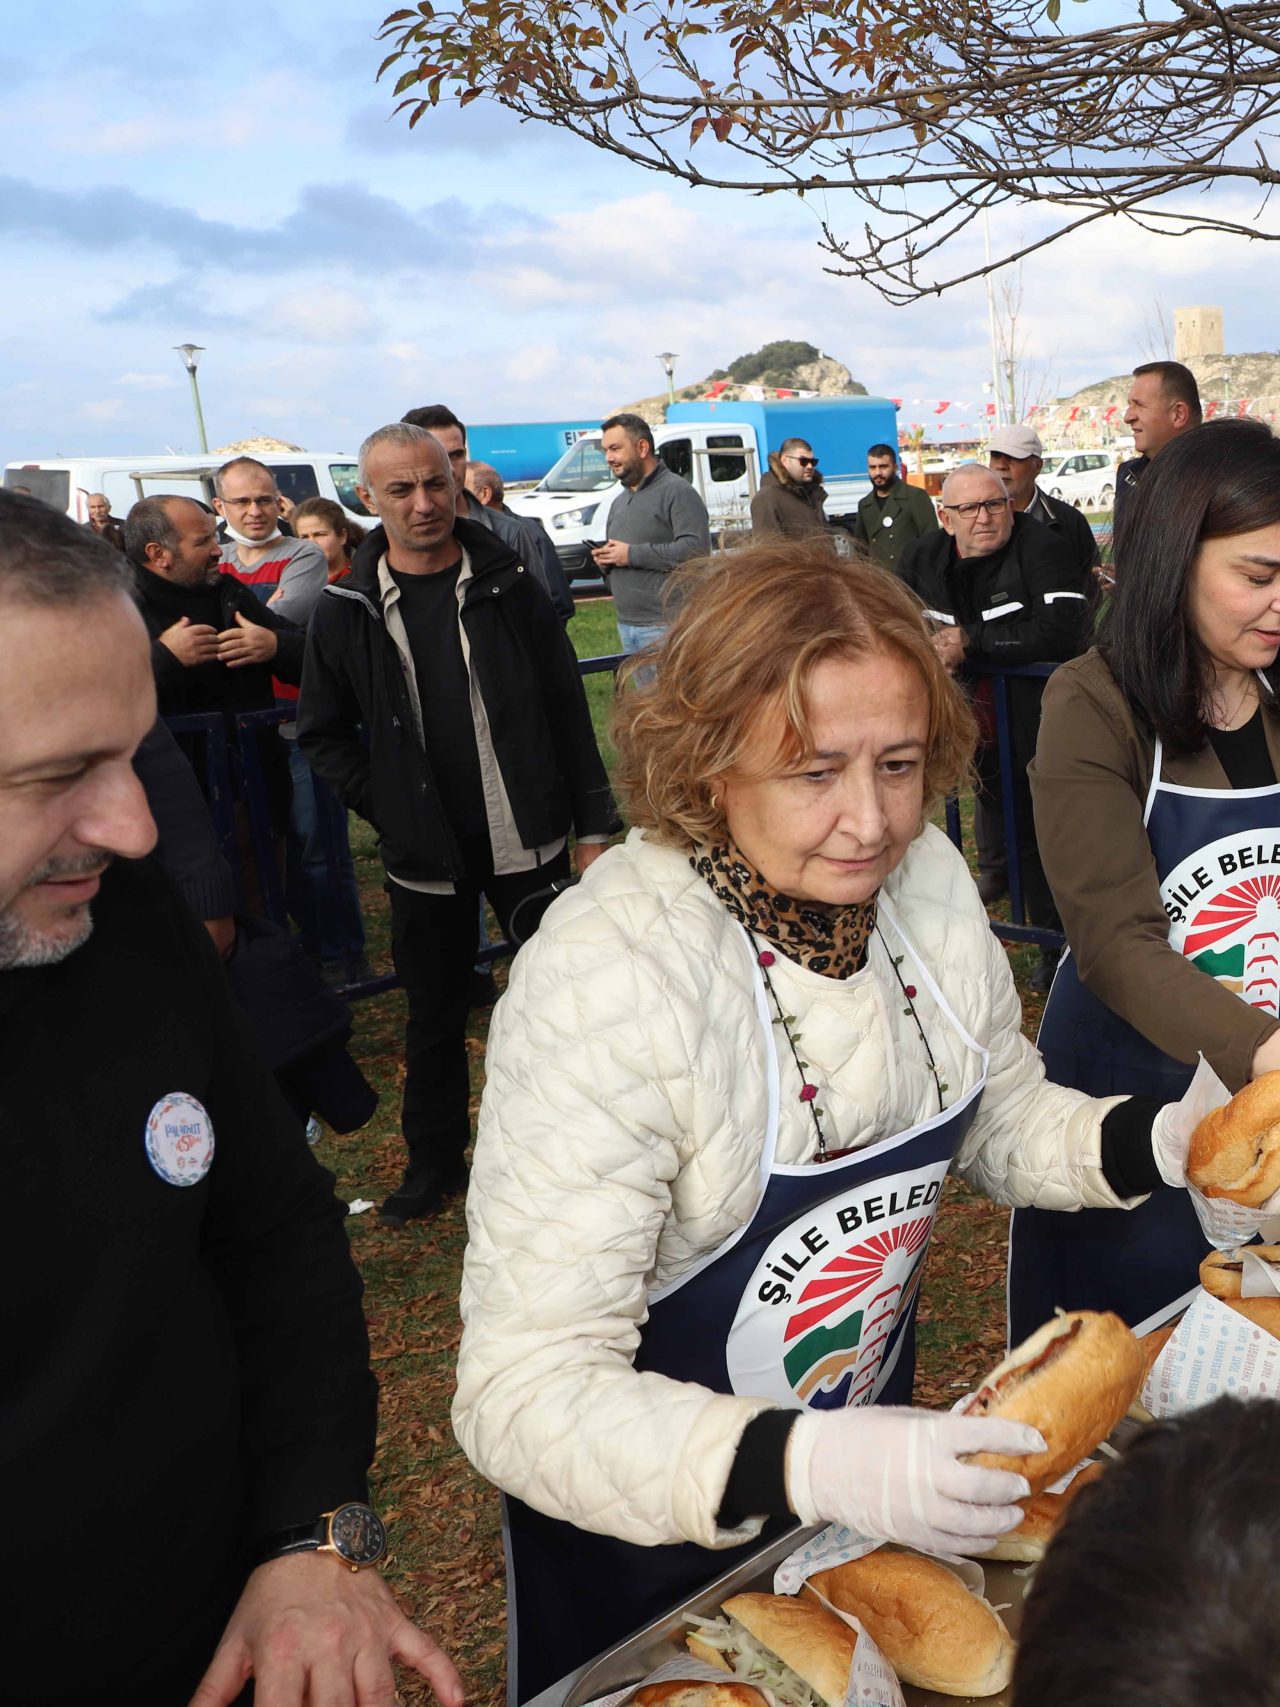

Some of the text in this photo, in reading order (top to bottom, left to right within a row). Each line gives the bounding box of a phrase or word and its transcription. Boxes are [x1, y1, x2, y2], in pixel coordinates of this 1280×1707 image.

[1164, 866, 1214, 924] ŞİLE
[758, 1181, 942, 1305] ŞİLE BELED
